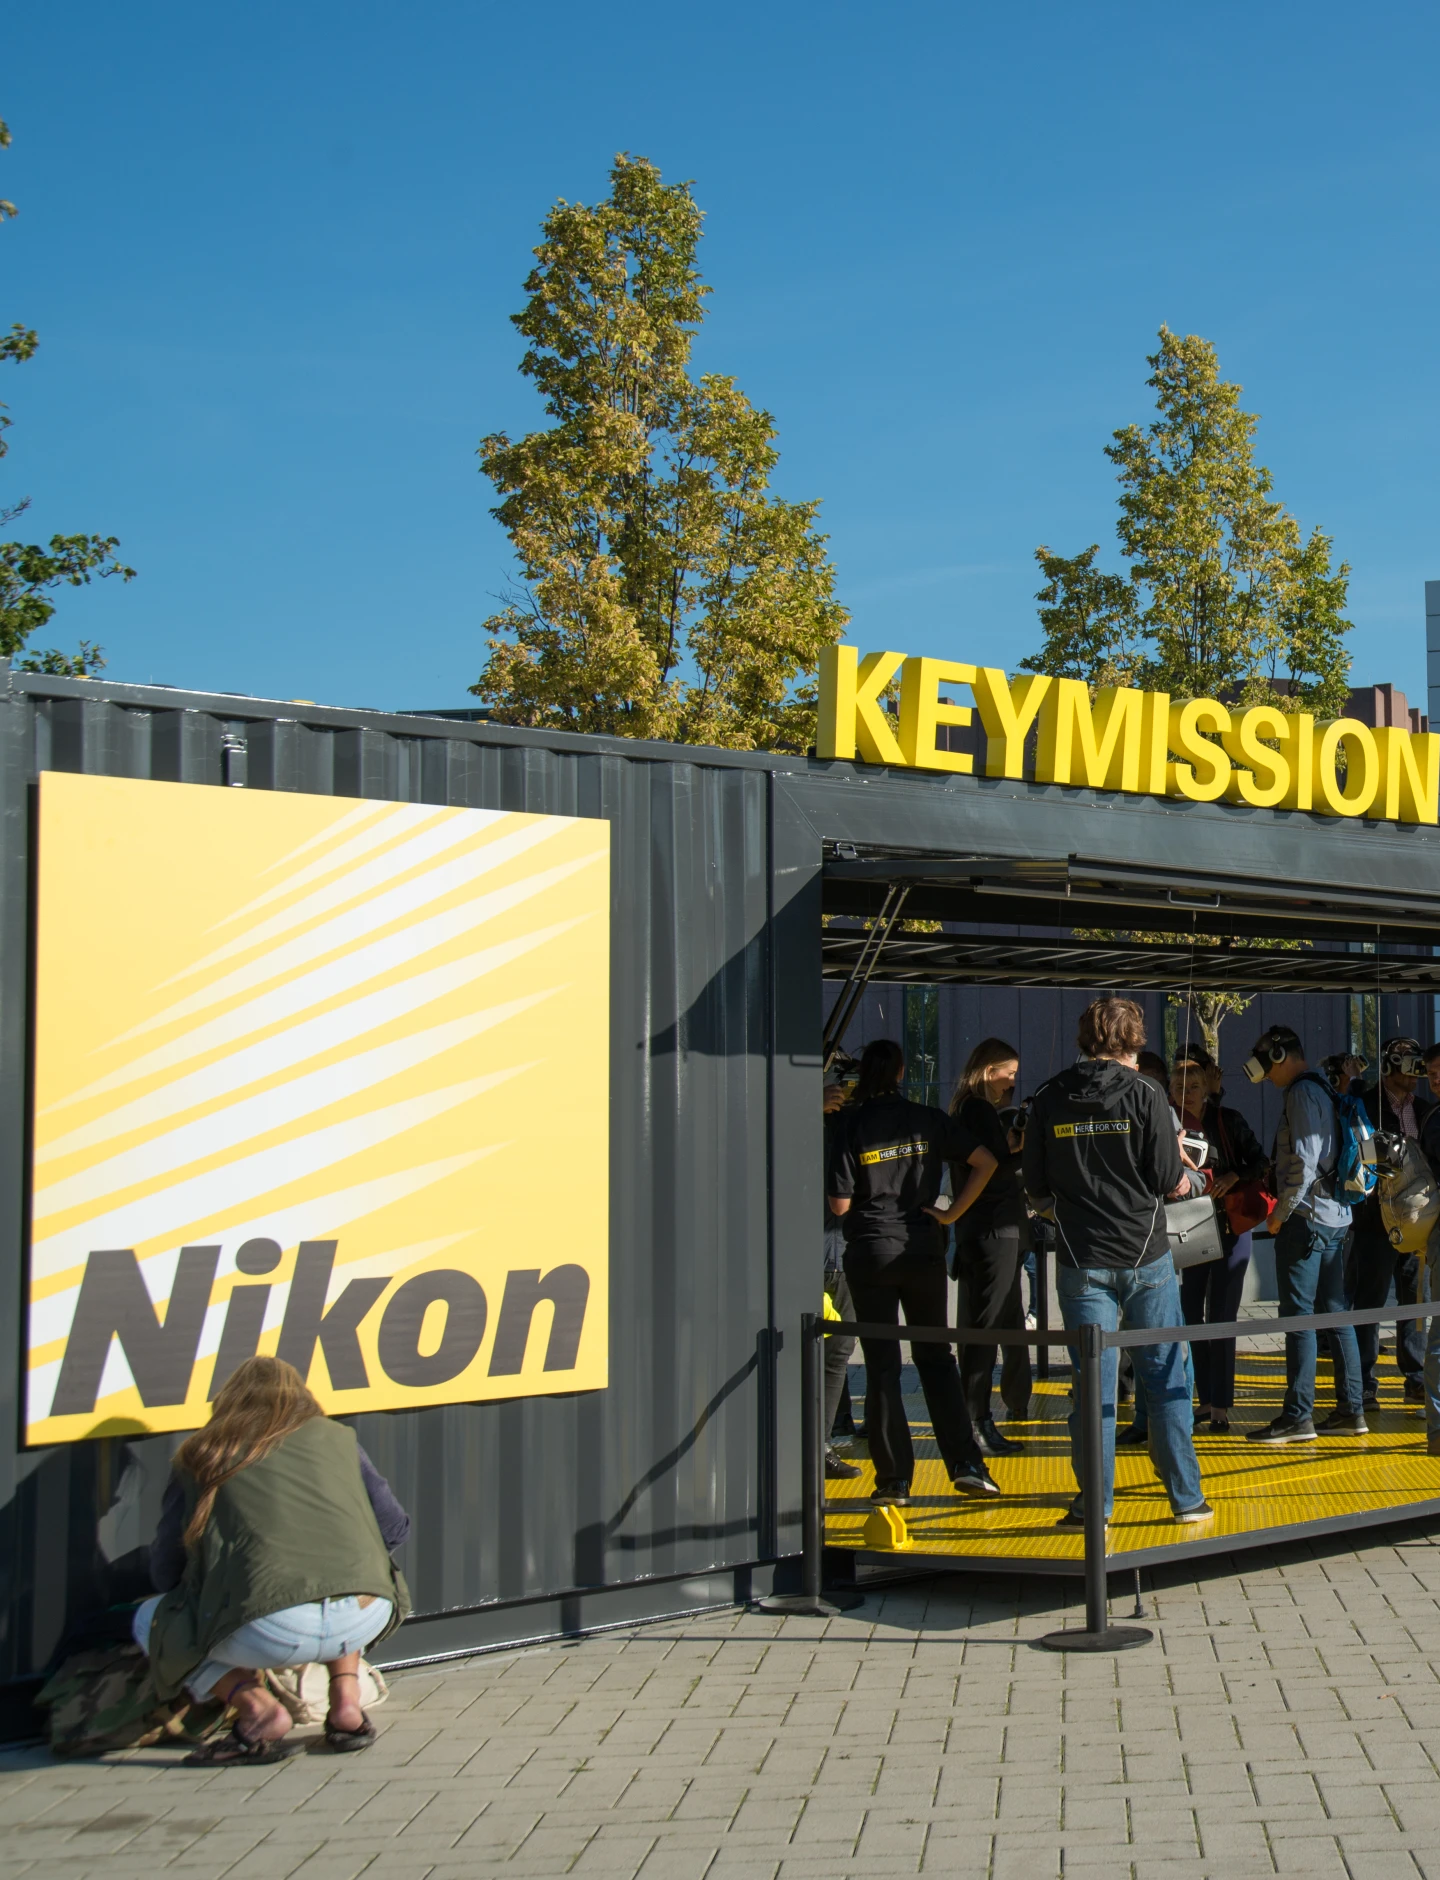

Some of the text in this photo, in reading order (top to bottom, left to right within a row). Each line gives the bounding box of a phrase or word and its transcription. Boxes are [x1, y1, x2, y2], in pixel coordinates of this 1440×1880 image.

[817, 644, 1440, 824] KEYMISSION
[866, 1153, 878, 1162] AM
[880, 1149, 897, 1159] HERE
[898, 1146, 912, 1155] FOR
[913, 1144, 927, 1152] YOU
[1075, 1124, 1094, 1133] HERE
[1095, 1123, 1110, 1132] FOR
[1111, 1122, 1129, 1131] YOU
[49, 1237, 591, 1418] Nikon
